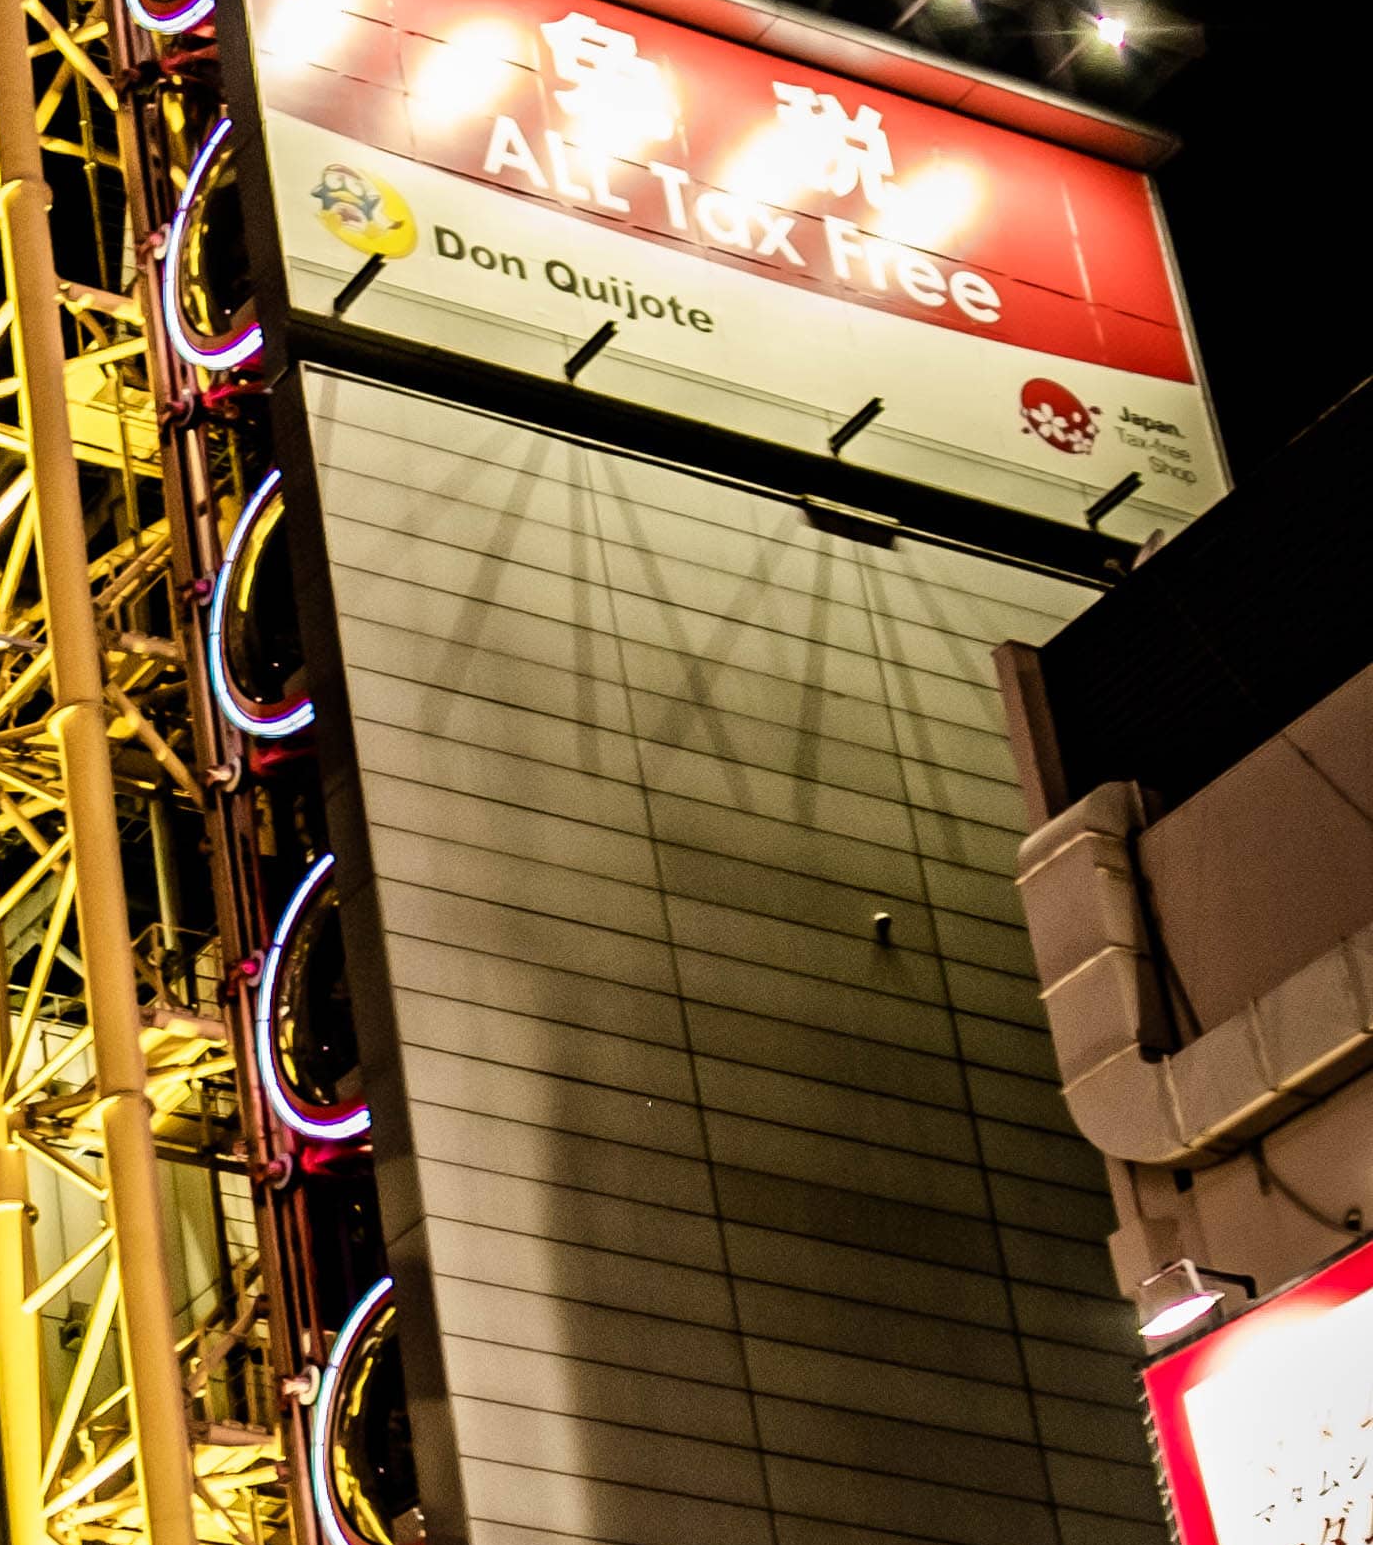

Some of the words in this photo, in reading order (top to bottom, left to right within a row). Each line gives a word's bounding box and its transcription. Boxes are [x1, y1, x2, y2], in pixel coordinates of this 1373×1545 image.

[432, 223, 528, 283] Don
[543, 257, 716, 336] Quijote
[651, 167, 809, 268] Tax
[825, 212, 1004, 326] Free
[1114, 425, 1192, 463] Tax-free
[1149, 455, 1198, 486] Shop
